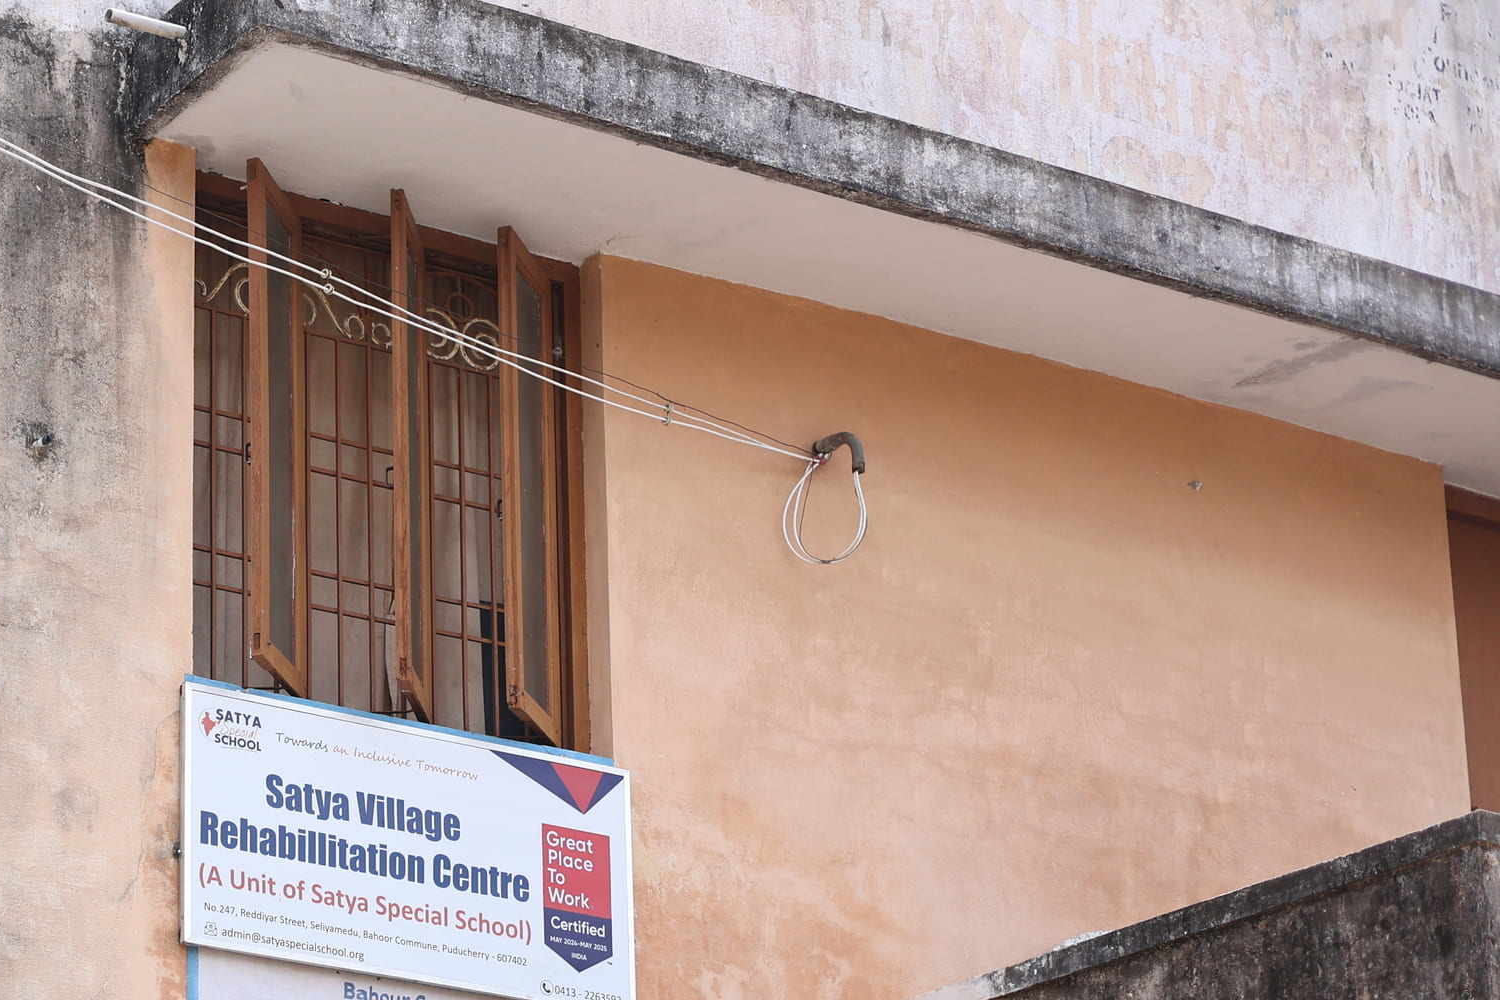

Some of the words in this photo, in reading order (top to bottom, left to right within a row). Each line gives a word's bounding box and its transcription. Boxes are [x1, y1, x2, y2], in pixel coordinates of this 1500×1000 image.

[216, 708, 262, 728] SATYA
[218, 720, 259, 739] Special
[214, 733, 262, 752] SCHOOL
[276, 732, 328, 753] Towards
[333, 745, 348, 756] an
[353, 746, 411, 767] Inclusive
[416, 759, 479, 781] Tomorrow
[265, 773, 350, 821] Satya
[356, 790, 461, 842] Village
[546, 830, 594, 854] Great
[200, 810, 425, 884] Rehabillitation
[432, 853, 530, 903] Centre
[547, 849, 594, 872] Place
[547, 867, 566, 885] To
[199, 862, 223, 888] (A
[230, 869, 276, 896] Unit
[283, 880, 306, 900] of
[311, 883, 368, 915] Satya
[375, 895, 448, 927] Special
[455, 910, 532, 946] School)
[204, 902, 238, 918] No.247,
[240, 908, 277, 925] Reddiyar
[279, 915, 308, 930] Street,
[310, 920, 361, 938] Seliyamedu,
[363, 929, 393, 944] Bahoor
[395, 936, 440, 953] Commune,
[442, 944, 489, 961] Puducherry
[496, 953, 527, 967] 607402
[550, 915, 606, 938] Certified
[221, 927, 365, 963] admin@satyaspecialschool.org
[550, 935, 563, 944] MAY
[594, 943, 607, 952] 2025
[571, 952, 588, 960] INDIA
[554, 985, 576, 998] 0413
